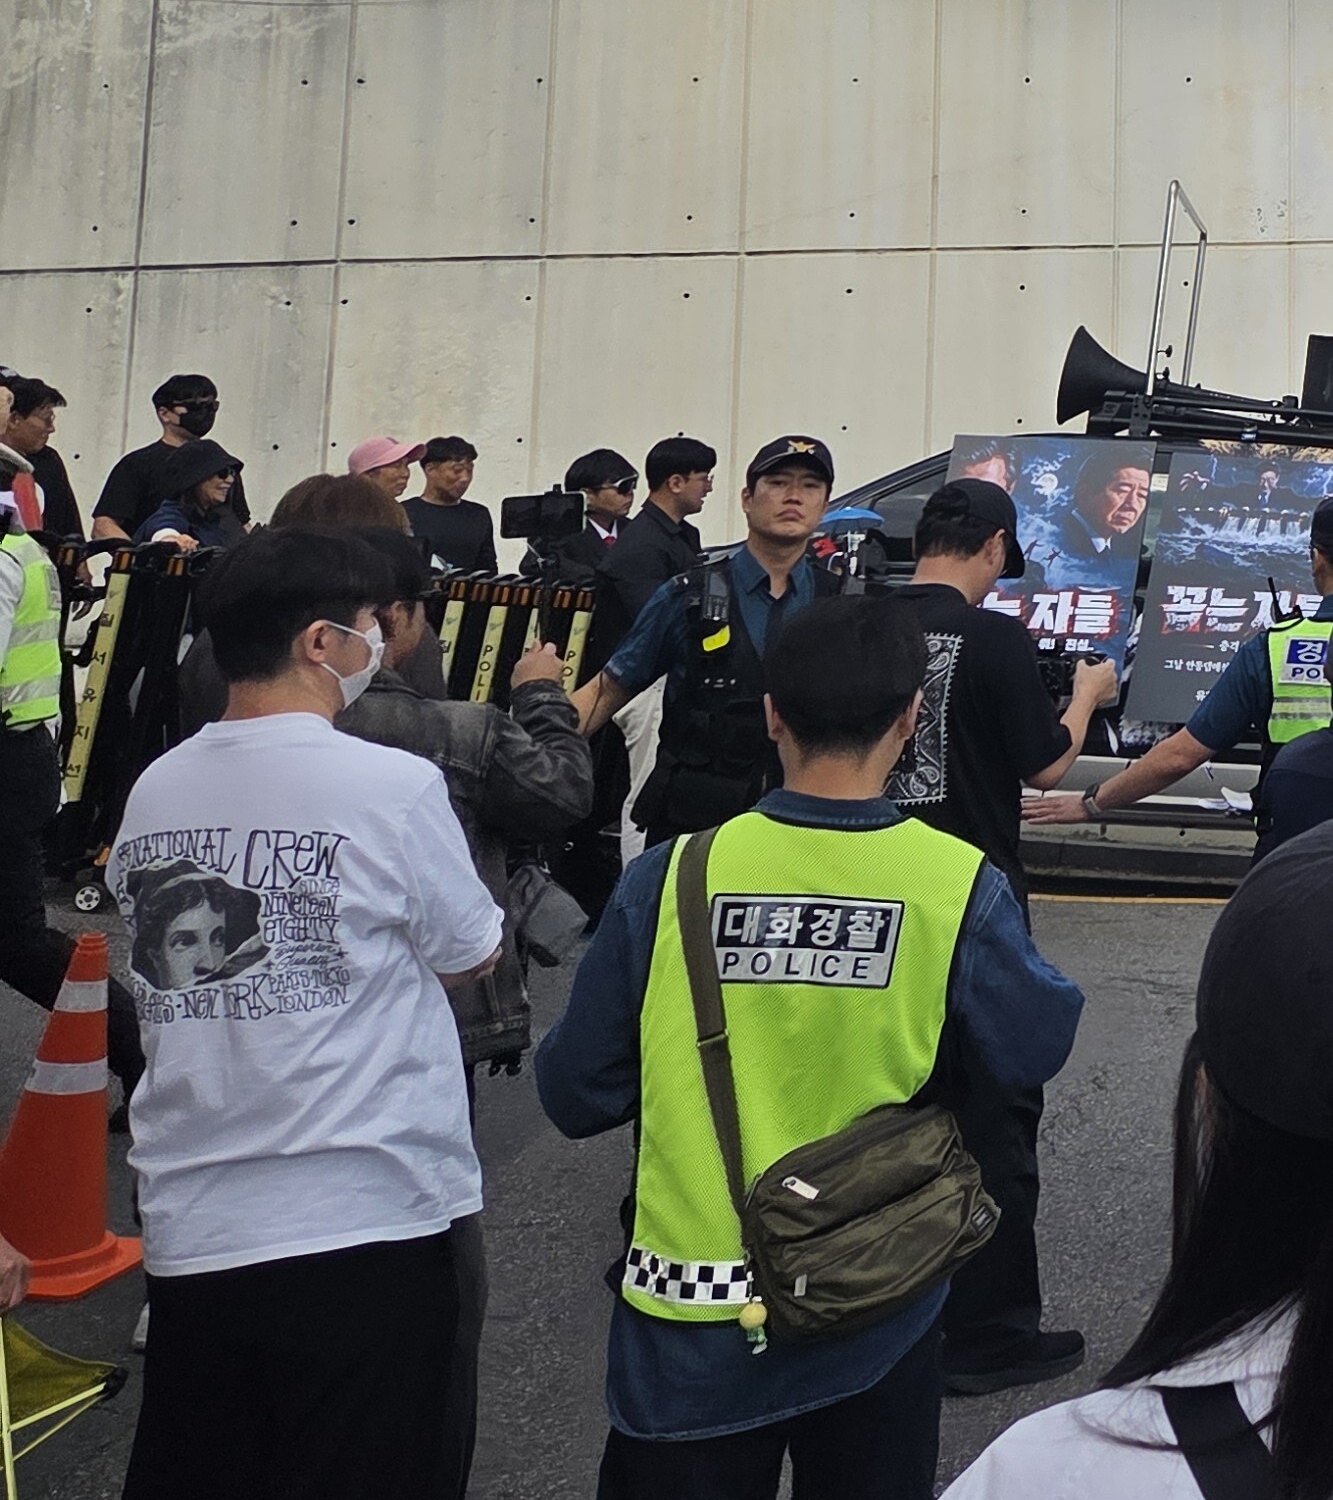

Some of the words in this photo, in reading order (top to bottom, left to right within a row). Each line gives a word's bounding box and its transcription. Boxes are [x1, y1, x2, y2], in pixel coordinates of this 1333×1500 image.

[1026, 591, 1114, 635] 자들
[1297, 641, 1323, 663] 경
[475, 644, 494, 701] POLI
[724, 905, 886, 950] 대화경찰
[721, 951, 872, 980] POLICE
[275, 984, 351, 1015] LONDON
